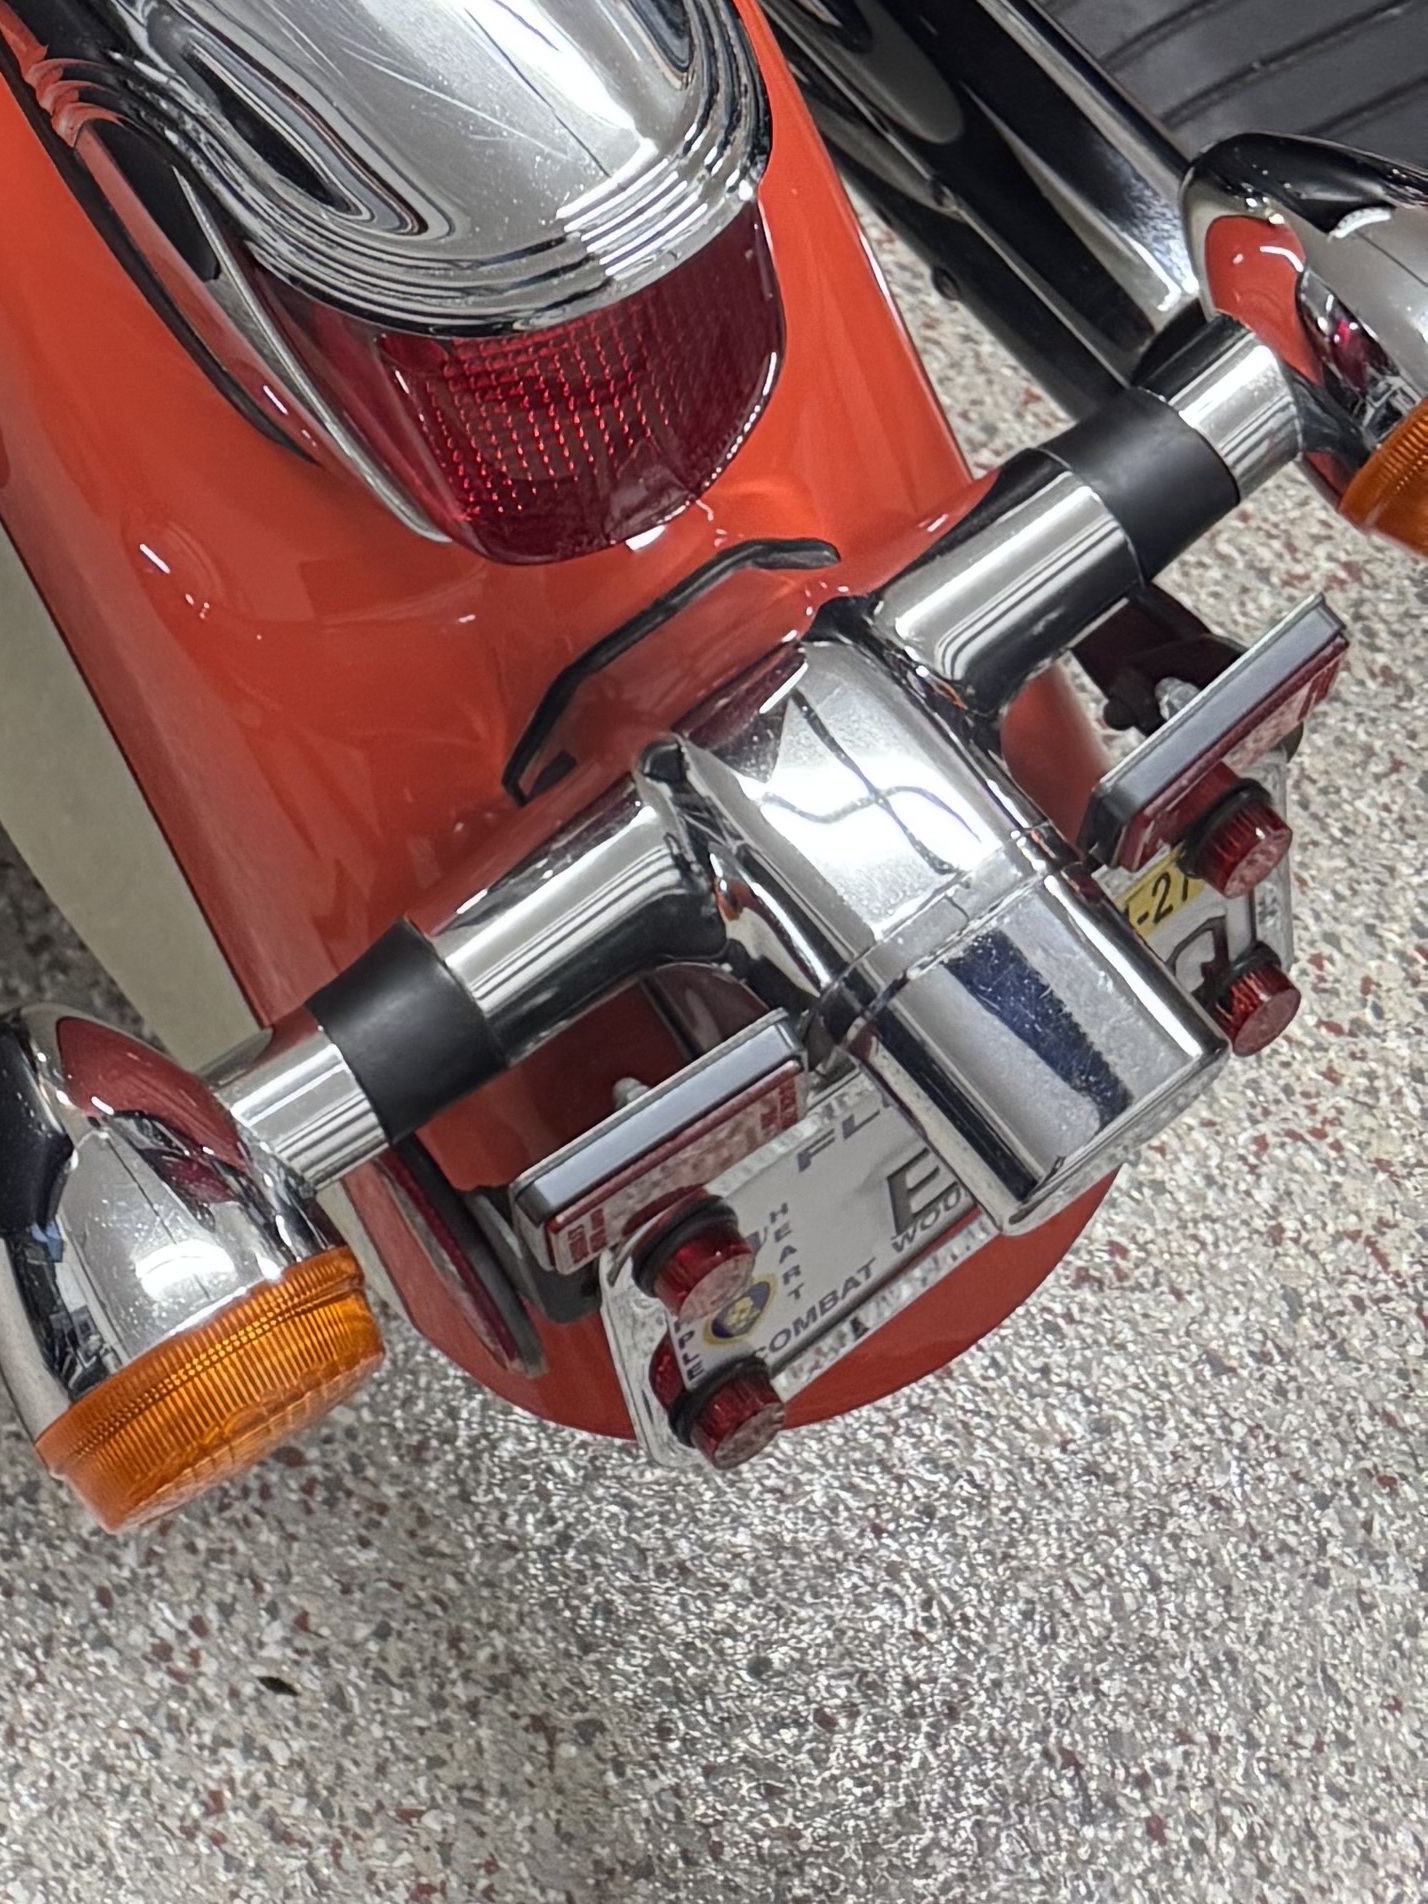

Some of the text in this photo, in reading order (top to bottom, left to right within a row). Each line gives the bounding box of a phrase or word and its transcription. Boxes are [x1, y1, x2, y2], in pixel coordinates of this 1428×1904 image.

[752, 1180, 962, 1361] COMBAT WOU
[768, 1201, 806, 1302] HEART
